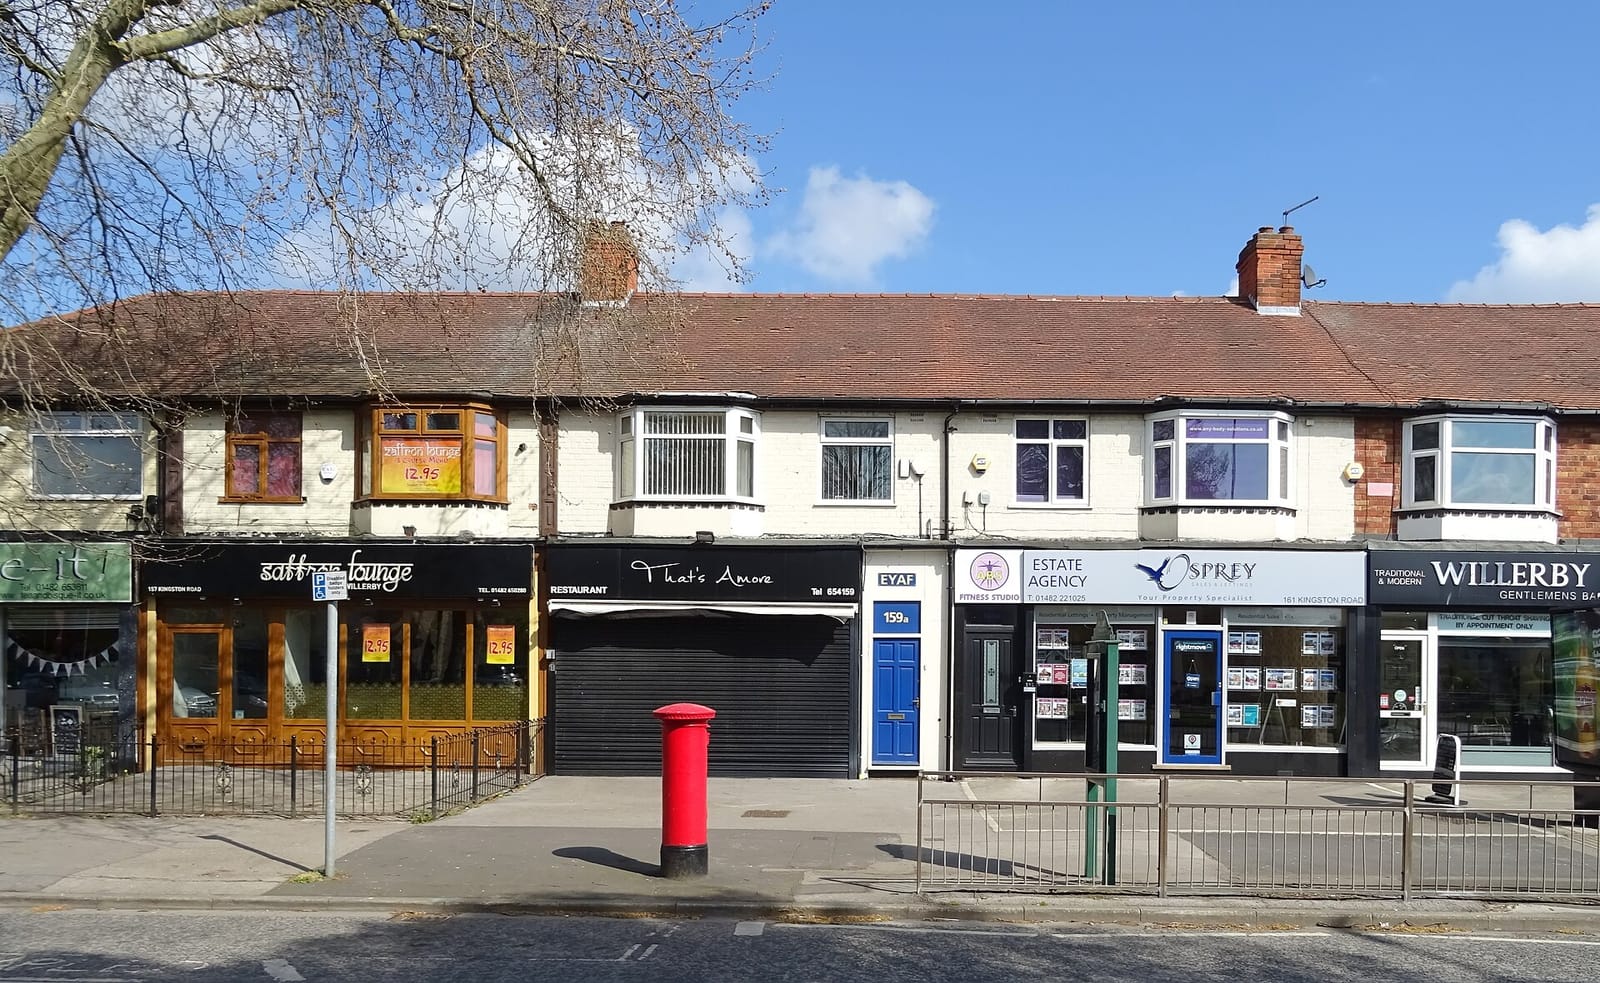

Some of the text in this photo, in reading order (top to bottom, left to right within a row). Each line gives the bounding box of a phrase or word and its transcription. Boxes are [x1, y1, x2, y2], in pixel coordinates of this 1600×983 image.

[426, 441, 462, 458] lounge
[406, 467, 440, 480] 12.95
[1033, 558, 1083, 571] ESTATE
[347, 549, 414, 592] lounge
[631, 560, 774, 587] That's Amore
[1160, 553, 1257, 591] OSPREY
[1374, 569, 1426, 578] TRADITIONAL
[1430, 561, 1591, 588] WILLERBY
[880, 574, 914, 585] EYAF
[1028, 575, 1087, 587] AGENCY
[1387, 577, 1422, 585] MODERN
[550, 586, 608, 594] RESTAURANT
[811, 588, 855, 596] Tel 654159
[1499, 591, 1577, 600] GENTLEMENS
[959, 593, 1020, 601] FITNESS STUDIO
[1035, 594, 1058, 602] 01482
[1060, 594, 1086, 602] 221025
[1163, 594, 1202, 602] Property
[1206, 594, 1253, 602] Specialist
[1284, 596, 1364, 604] 161 KINGSTON ROAD
[883, 611, 909, 623] 159a
[1515, 622, 1534, 630] ONLY
[364, 639, 389, 652] 12.95
[489, 641, 513, 655] 12.95
